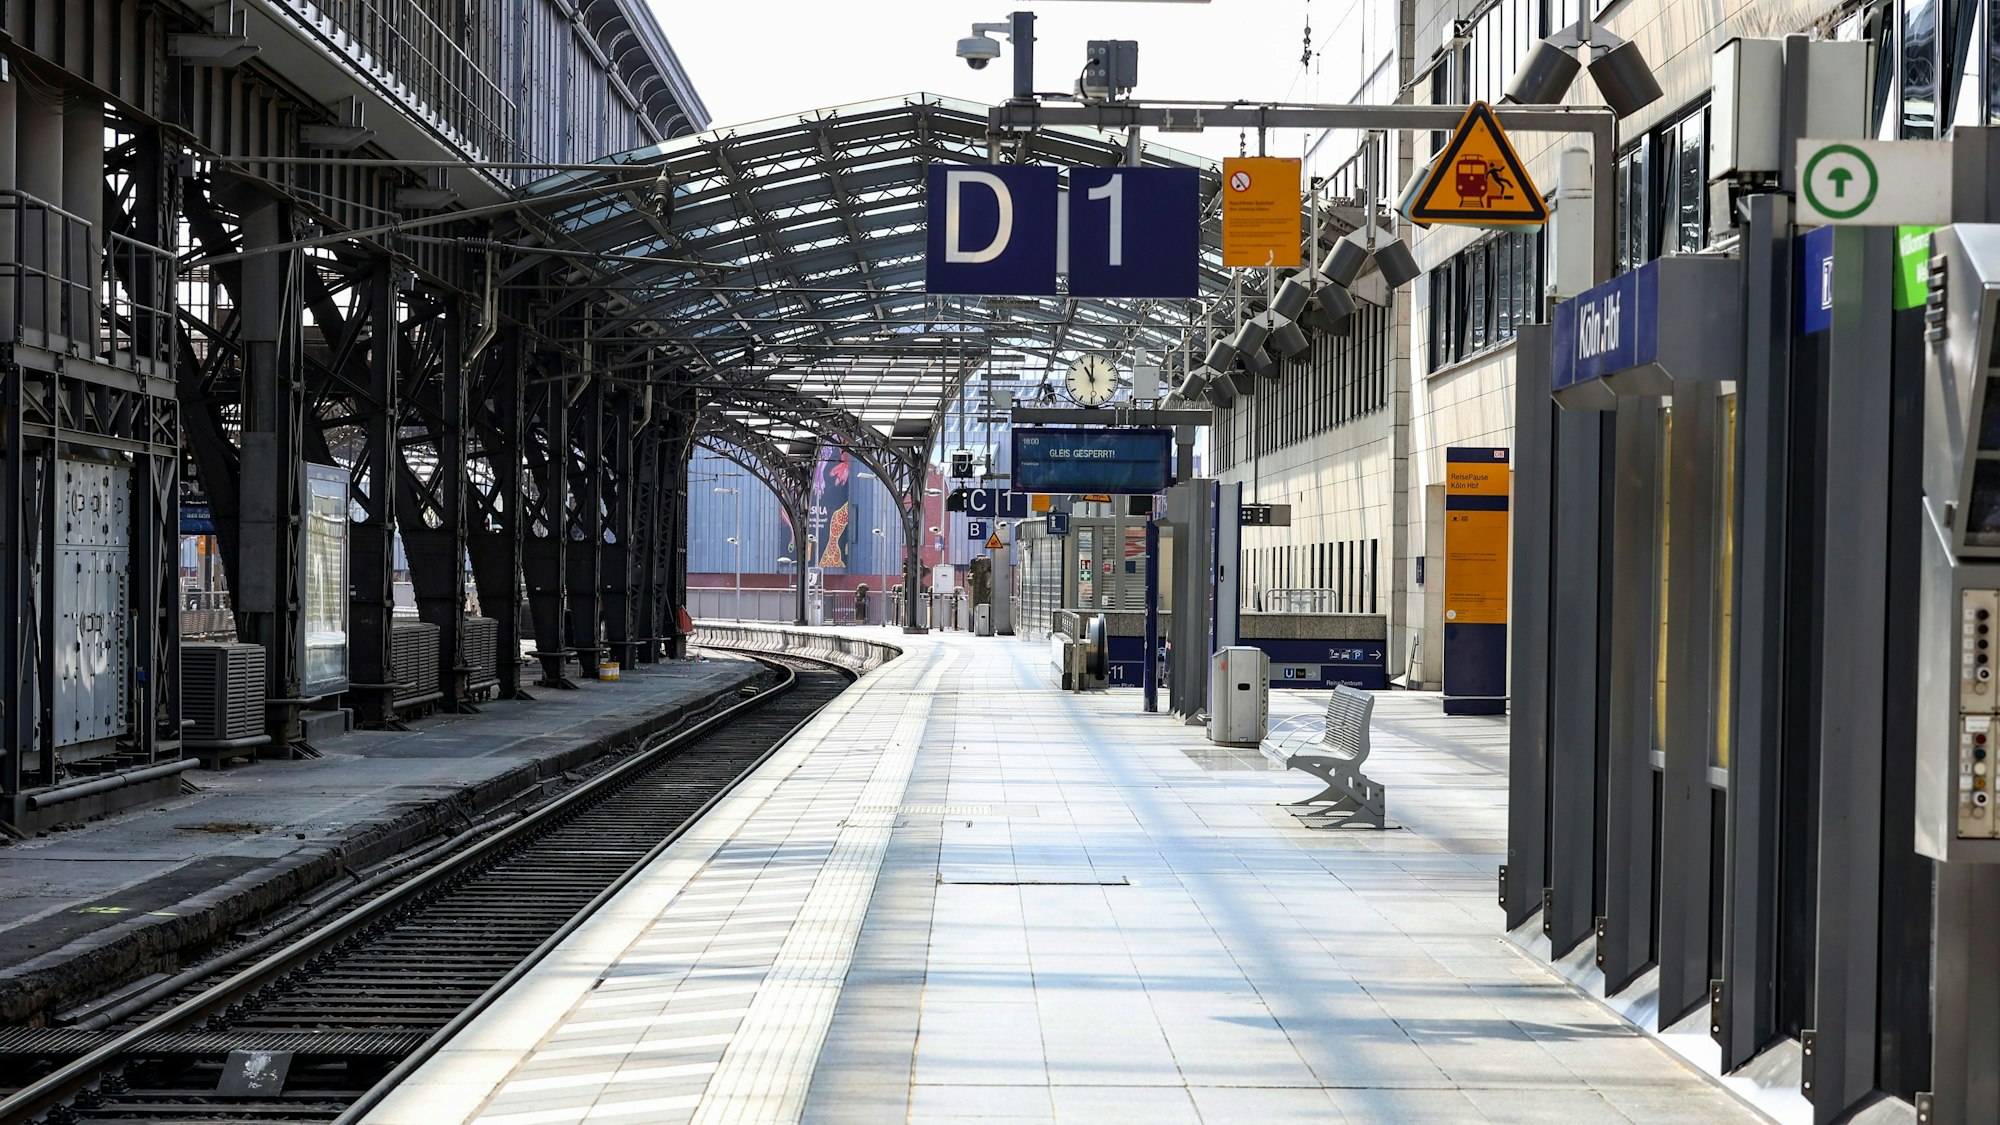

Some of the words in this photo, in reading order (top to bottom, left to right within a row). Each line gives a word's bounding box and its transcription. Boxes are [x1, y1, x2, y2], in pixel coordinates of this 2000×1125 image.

[945, 170, 1013, 264] D
[1087, 173, 1123, 266] 1
[1579, 301, 1601, 360] Köln
[1603, 290, 1620, 353] Hbf
[1049, 448, 1071, 458] GLEIS
[1073, 449, 1115, 458] GESPERRT!
[1451, 473, 1488, 481] ReisePause
[1451, 481, 1466, 489] Köln
[970, 489, 987, 511] C
[1002, 490, 1011, 511] 1
[970, 522, 980, 536] B
[1285, 669, 1293, 678] U
